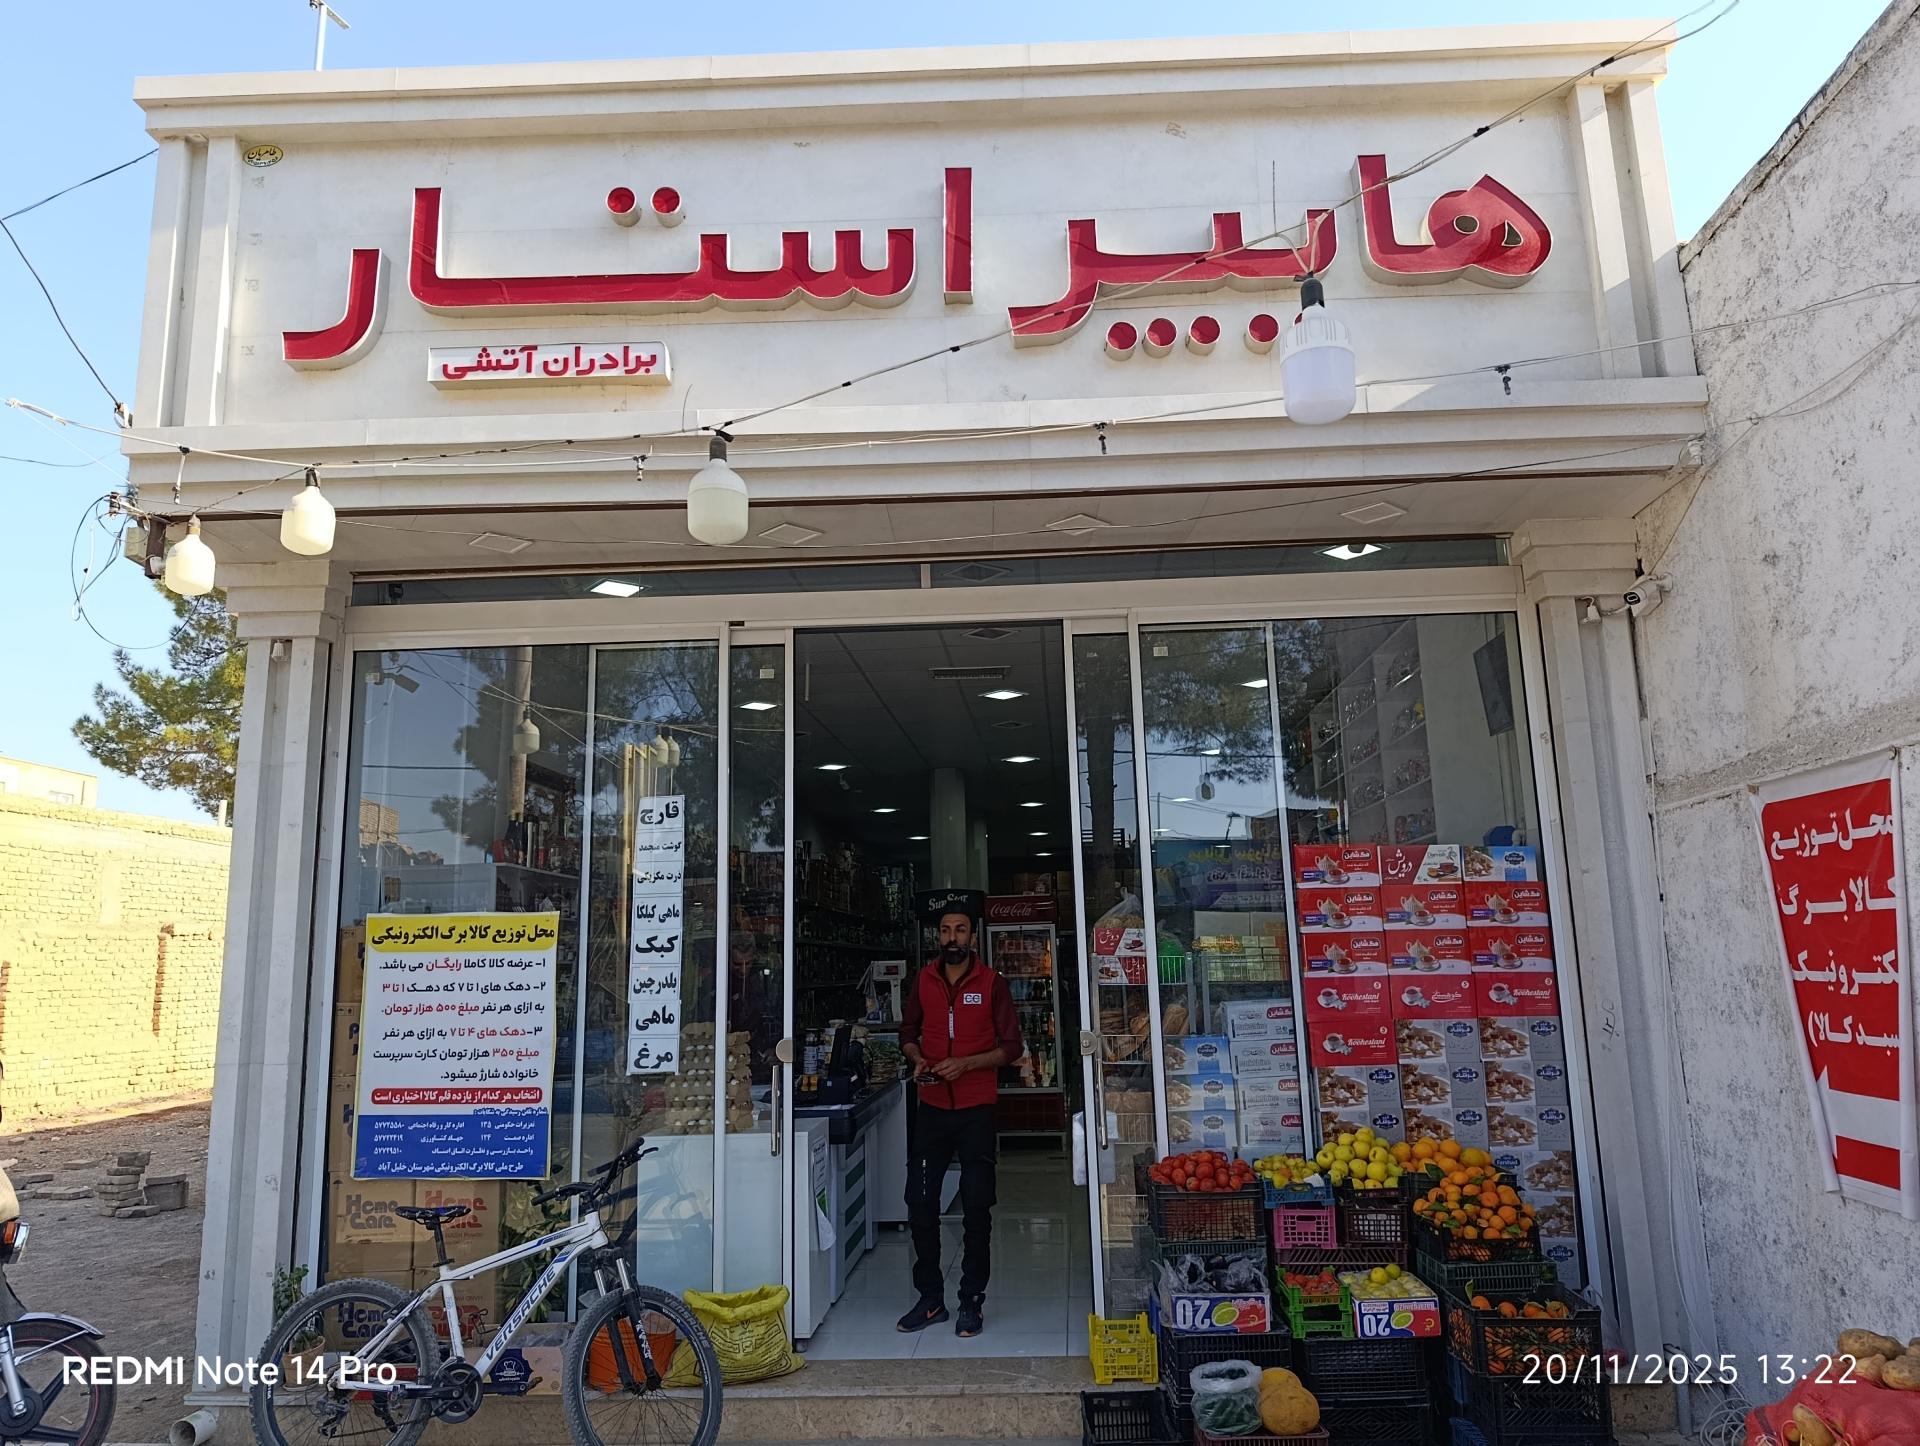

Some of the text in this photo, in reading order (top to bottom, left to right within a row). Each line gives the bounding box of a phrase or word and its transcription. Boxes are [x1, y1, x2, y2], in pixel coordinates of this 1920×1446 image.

[282, 167, 973, 369] استار
[442, 345, 657, 380] برادران آتشی
[640, 801, 680, 825] قارچ
[1770, 812, 1838, 861] توزیع
[636, 903, 680, 923] ماهی کیلکا
[371, 924, 438, 945] الکترونیکی
[492, 924, 527, 944] توزیع
[528, 925, 555, 942] محل
[635, 935, 679, 958] کبک
[426, 957, 462, 971] رایگان
[464, 958, 487, 969] کاملا
[489, 958, 505, 968] کالا
[507, 958, 533, 970] عرضه
[382, 984, 391, 993] ۳
[392, 983, 400, 993] تا
[406, 982, 441, 992] دهک
[442, 982, 456, 992] که
[458, 983, 465, 992] ۷
[466, 982, 475, 992] تا
[481, 982, 502, 994] های
[504, 981, 531, 992] دهک
[633, 971, 677, 995] بلدرچین
[413, 1003, 434, 1015] هزار
[436, 1003, 456, 1012] ۵۰۰
[457, 1002, 480, 1016] مبلغ
[481, 1002, 497, 1014] نفر
[497, 1003, 512, 1014] هر
[514, 1002, 533, 1013] ازای
[534, 1003, 545, 1013] به
[635, 1005, 675, 1031] ماهی
[382, 1028, 400, 1040] نفر
[401, 1029, 415, 1040] هر
[417, 1027, 435, 1039] ازای
[437, 1028, 447, 1038] به
[450, 1028, 457, 1036] ۷
[458, 1027, 466, 1036] تا
[467, 1027, 475, 1037] ۴
[477, 1027, 497, 1039] های
[373, 1048, 539, 1062] مبلغ ۳۵۰ هزار تومان کارت سرپرست
[633, 1043, 673, 1069] مرغ
[478, 1068, 500, 1081] شارژ
[502, 1068, 539, 1080] خانواده
[374, 1090, 540, 1103] انتخاب هر کدام از یازده قلم کالا اختیاری است
[407, 1162, 434, 1172] شهرستان
[435, 1162, 469, 1172] الکترونیکی
[508, 1162, 524, 1172] طرح
[350, 1212, 396, 1230] Care
[486, 1266, 556, 1360] VERSACHE
[1176, 1299, 1211, 1330] 20
[1362, 1314, 1391, 1337] 20
